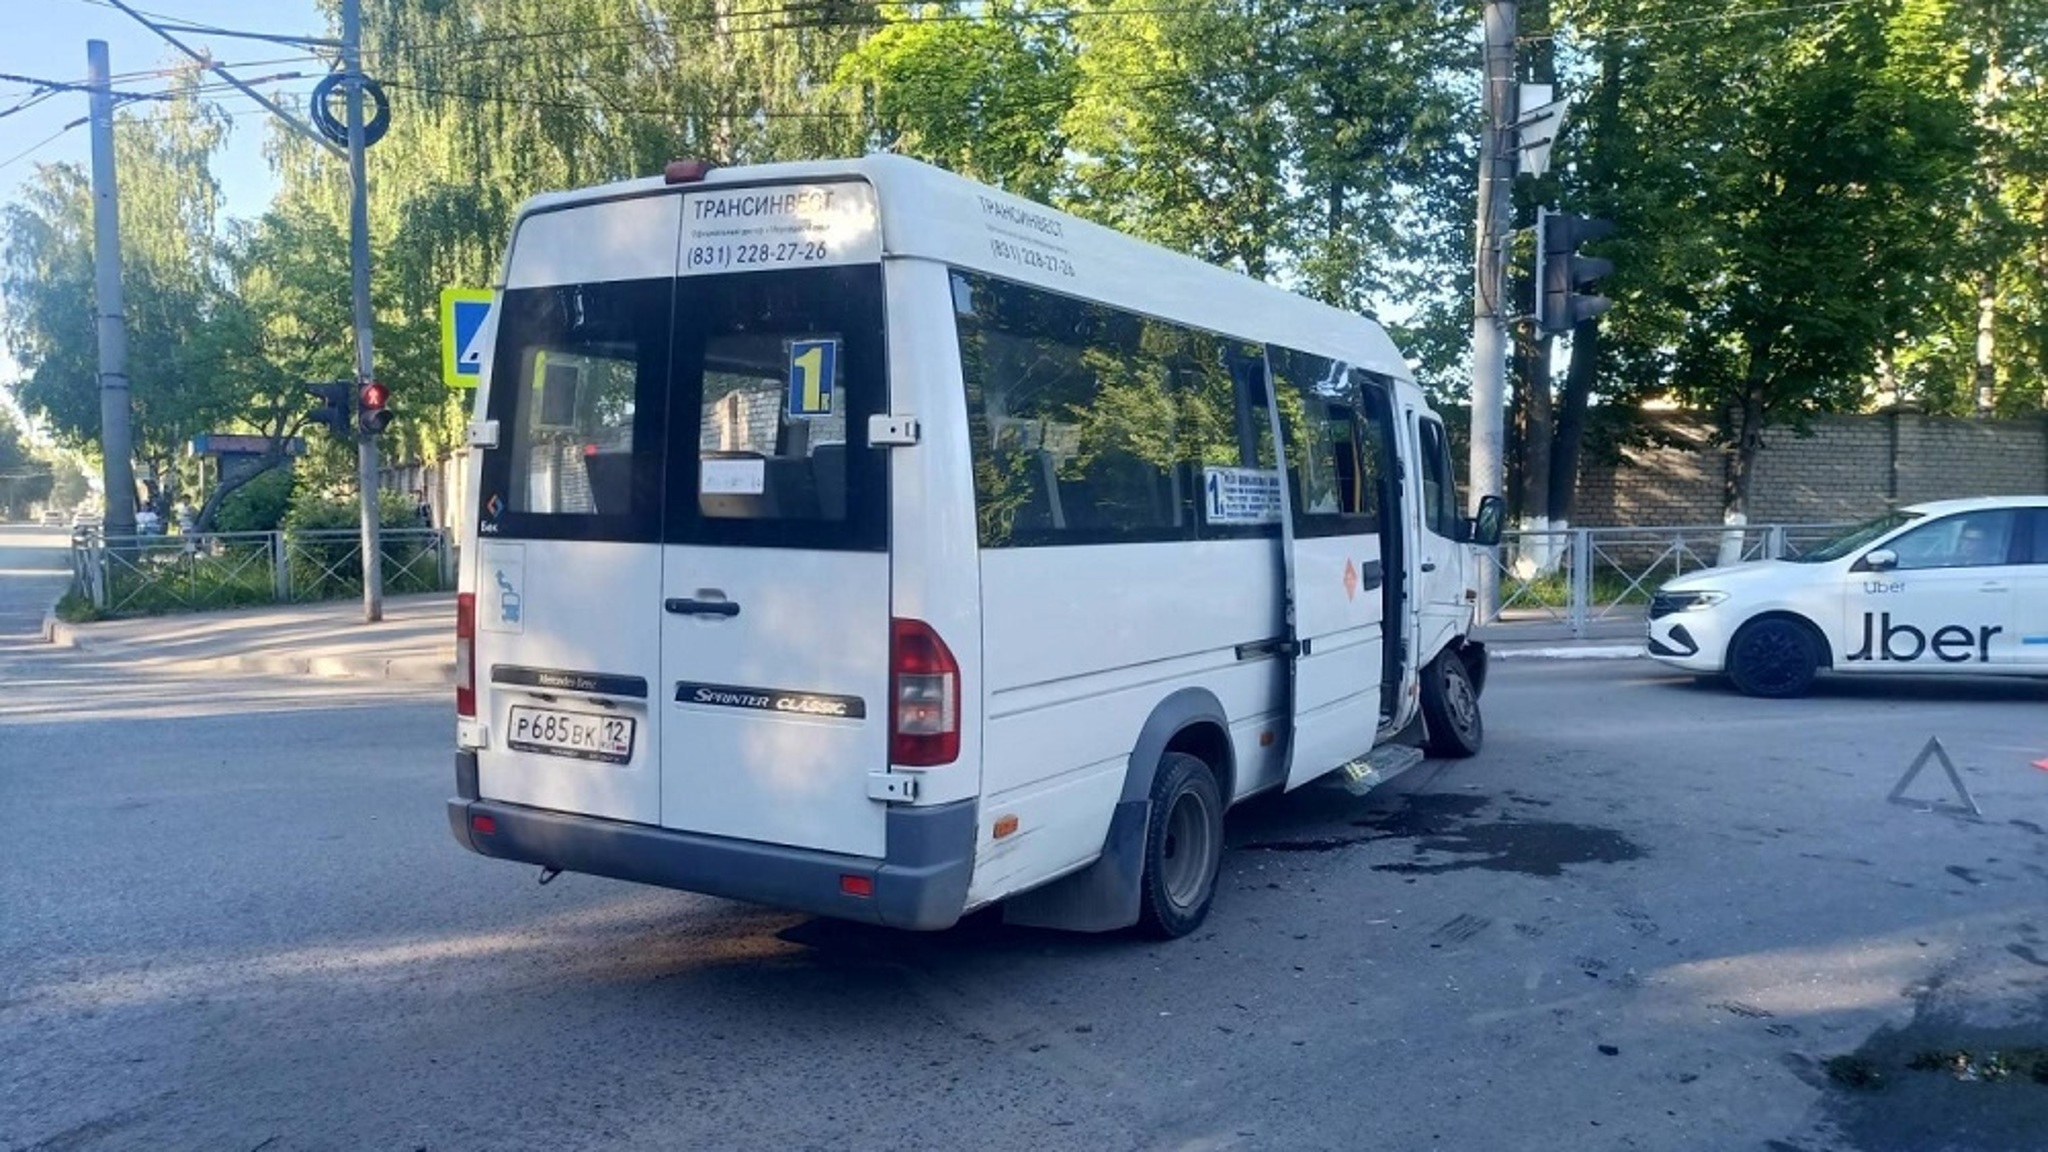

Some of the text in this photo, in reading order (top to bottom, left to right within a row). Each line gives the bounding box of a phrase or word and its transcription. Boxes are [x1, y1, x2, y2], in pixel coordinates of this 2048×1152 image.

[694, 191, 835, 219] ТРАНСИНВЕСТ
[978, 195, 1063, 238] ТРАНСИНВЕСТ
[687, 241, 827, 268] (831) 228-27-26
[1863, 581, 1905, 594] Uber
